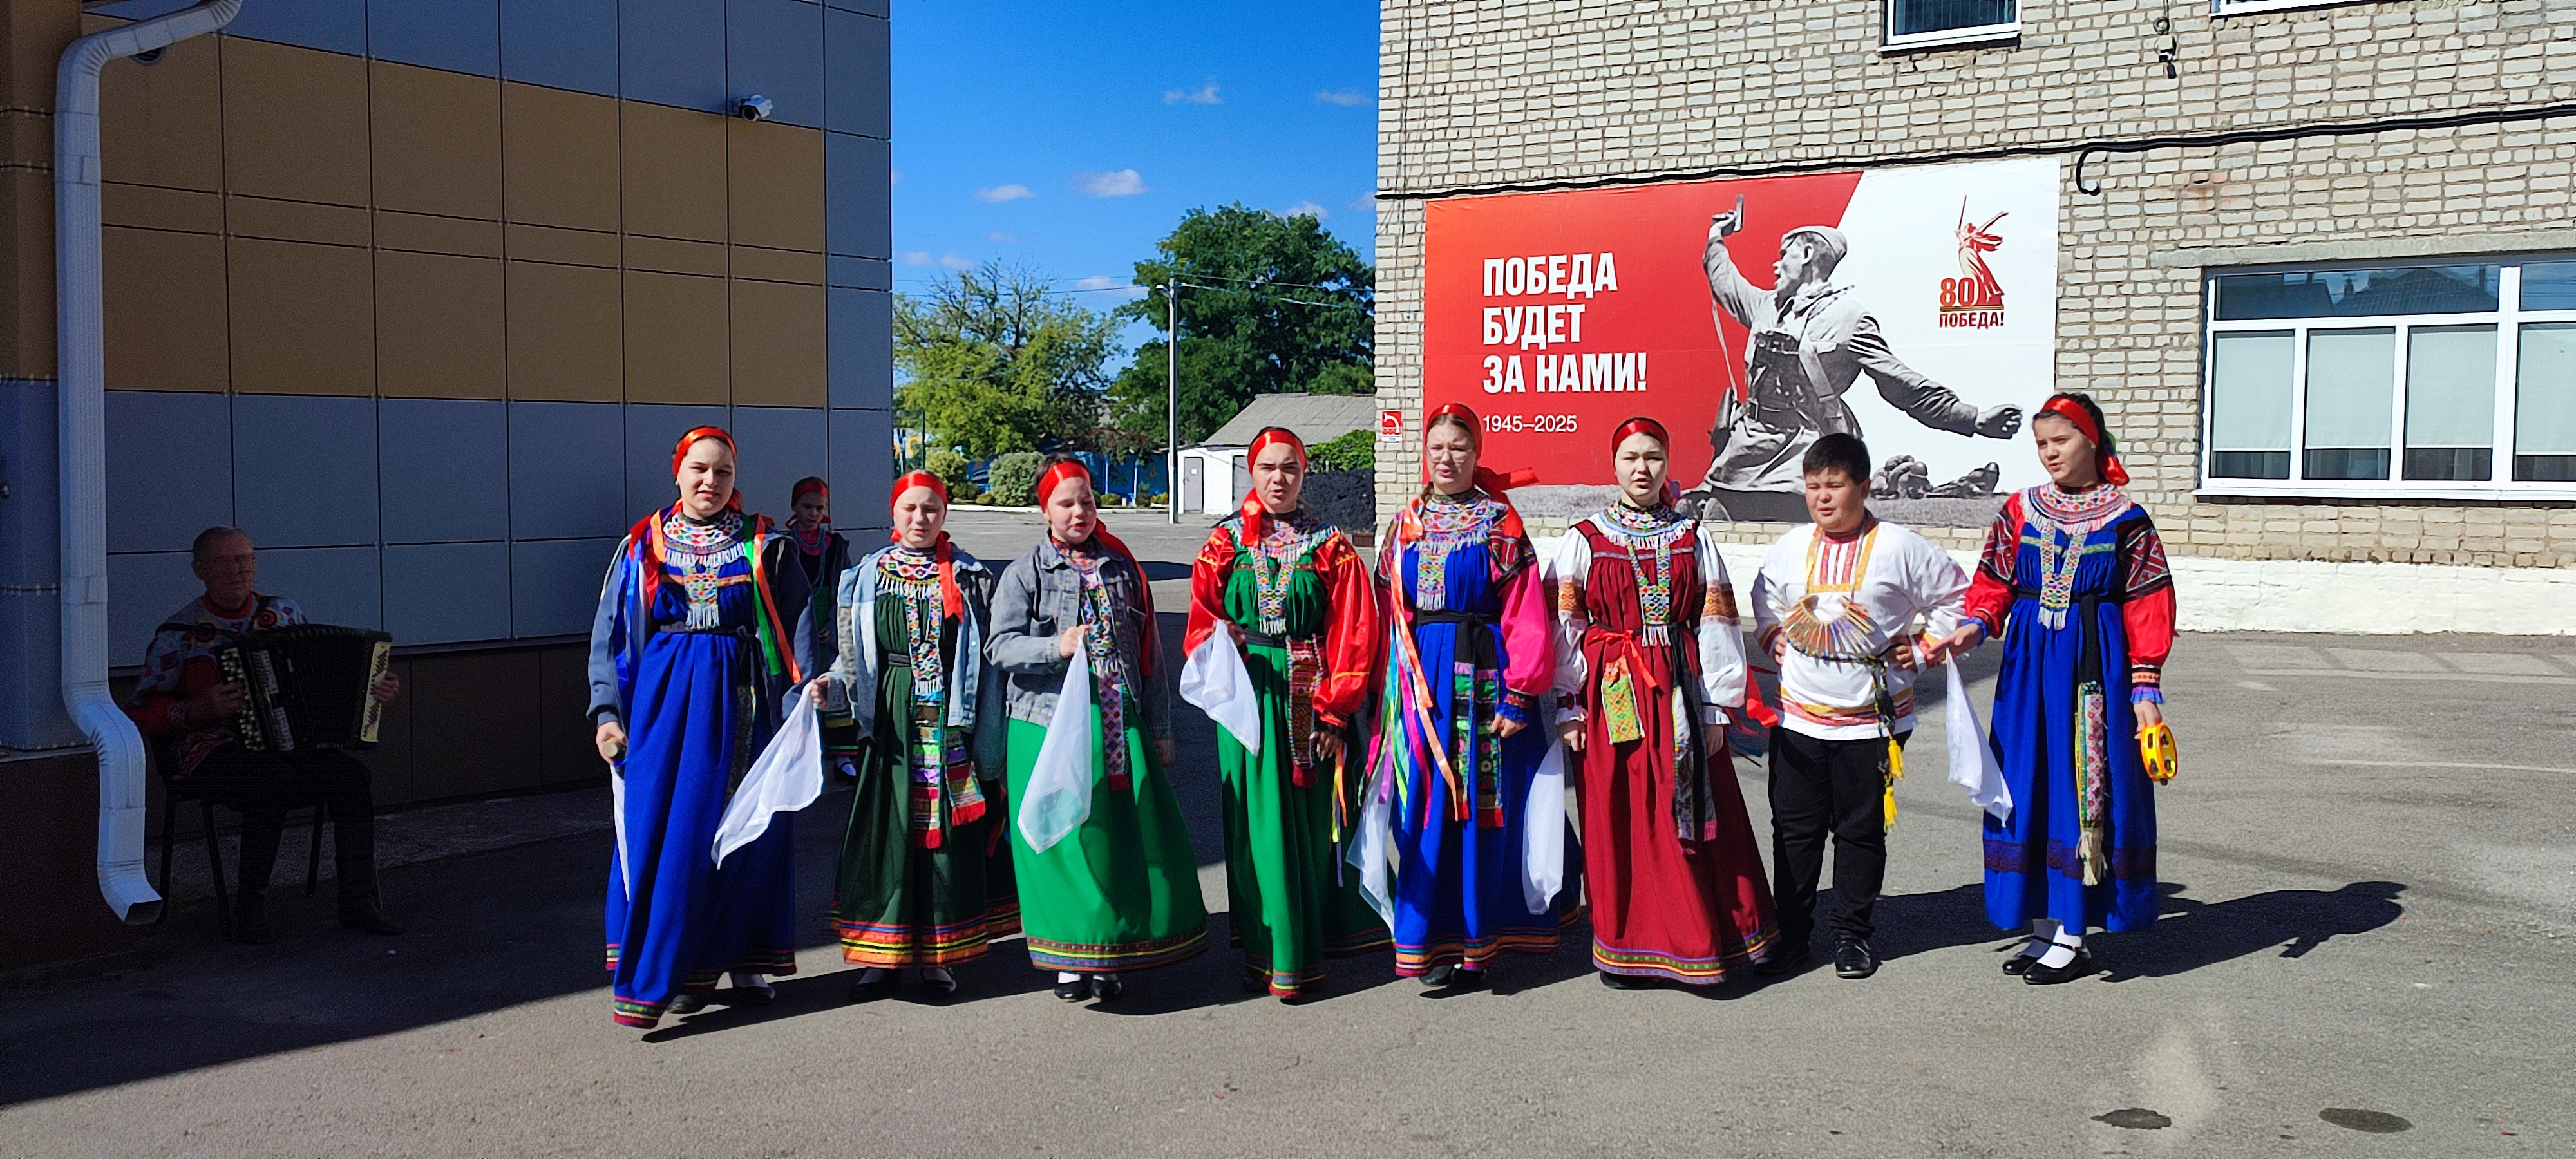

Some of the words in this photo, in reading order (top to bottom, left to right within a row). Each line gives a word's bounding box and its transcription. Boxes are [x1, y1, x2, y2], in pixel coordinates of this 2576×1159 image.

[1483, 252, 1618, 299] ПОБЕДА
[1940, 277, 1975, 307] 80
[1482, 303, 1586, 350] БУДЕТ
[1938, 312, 2004, 330] ПОБЕДА!
[1482, 355, 1526, 393] ЗА
[1535, 352, 1647, 393] НАМИ!
[1482, 415, 1577, 433] 1945–2025
